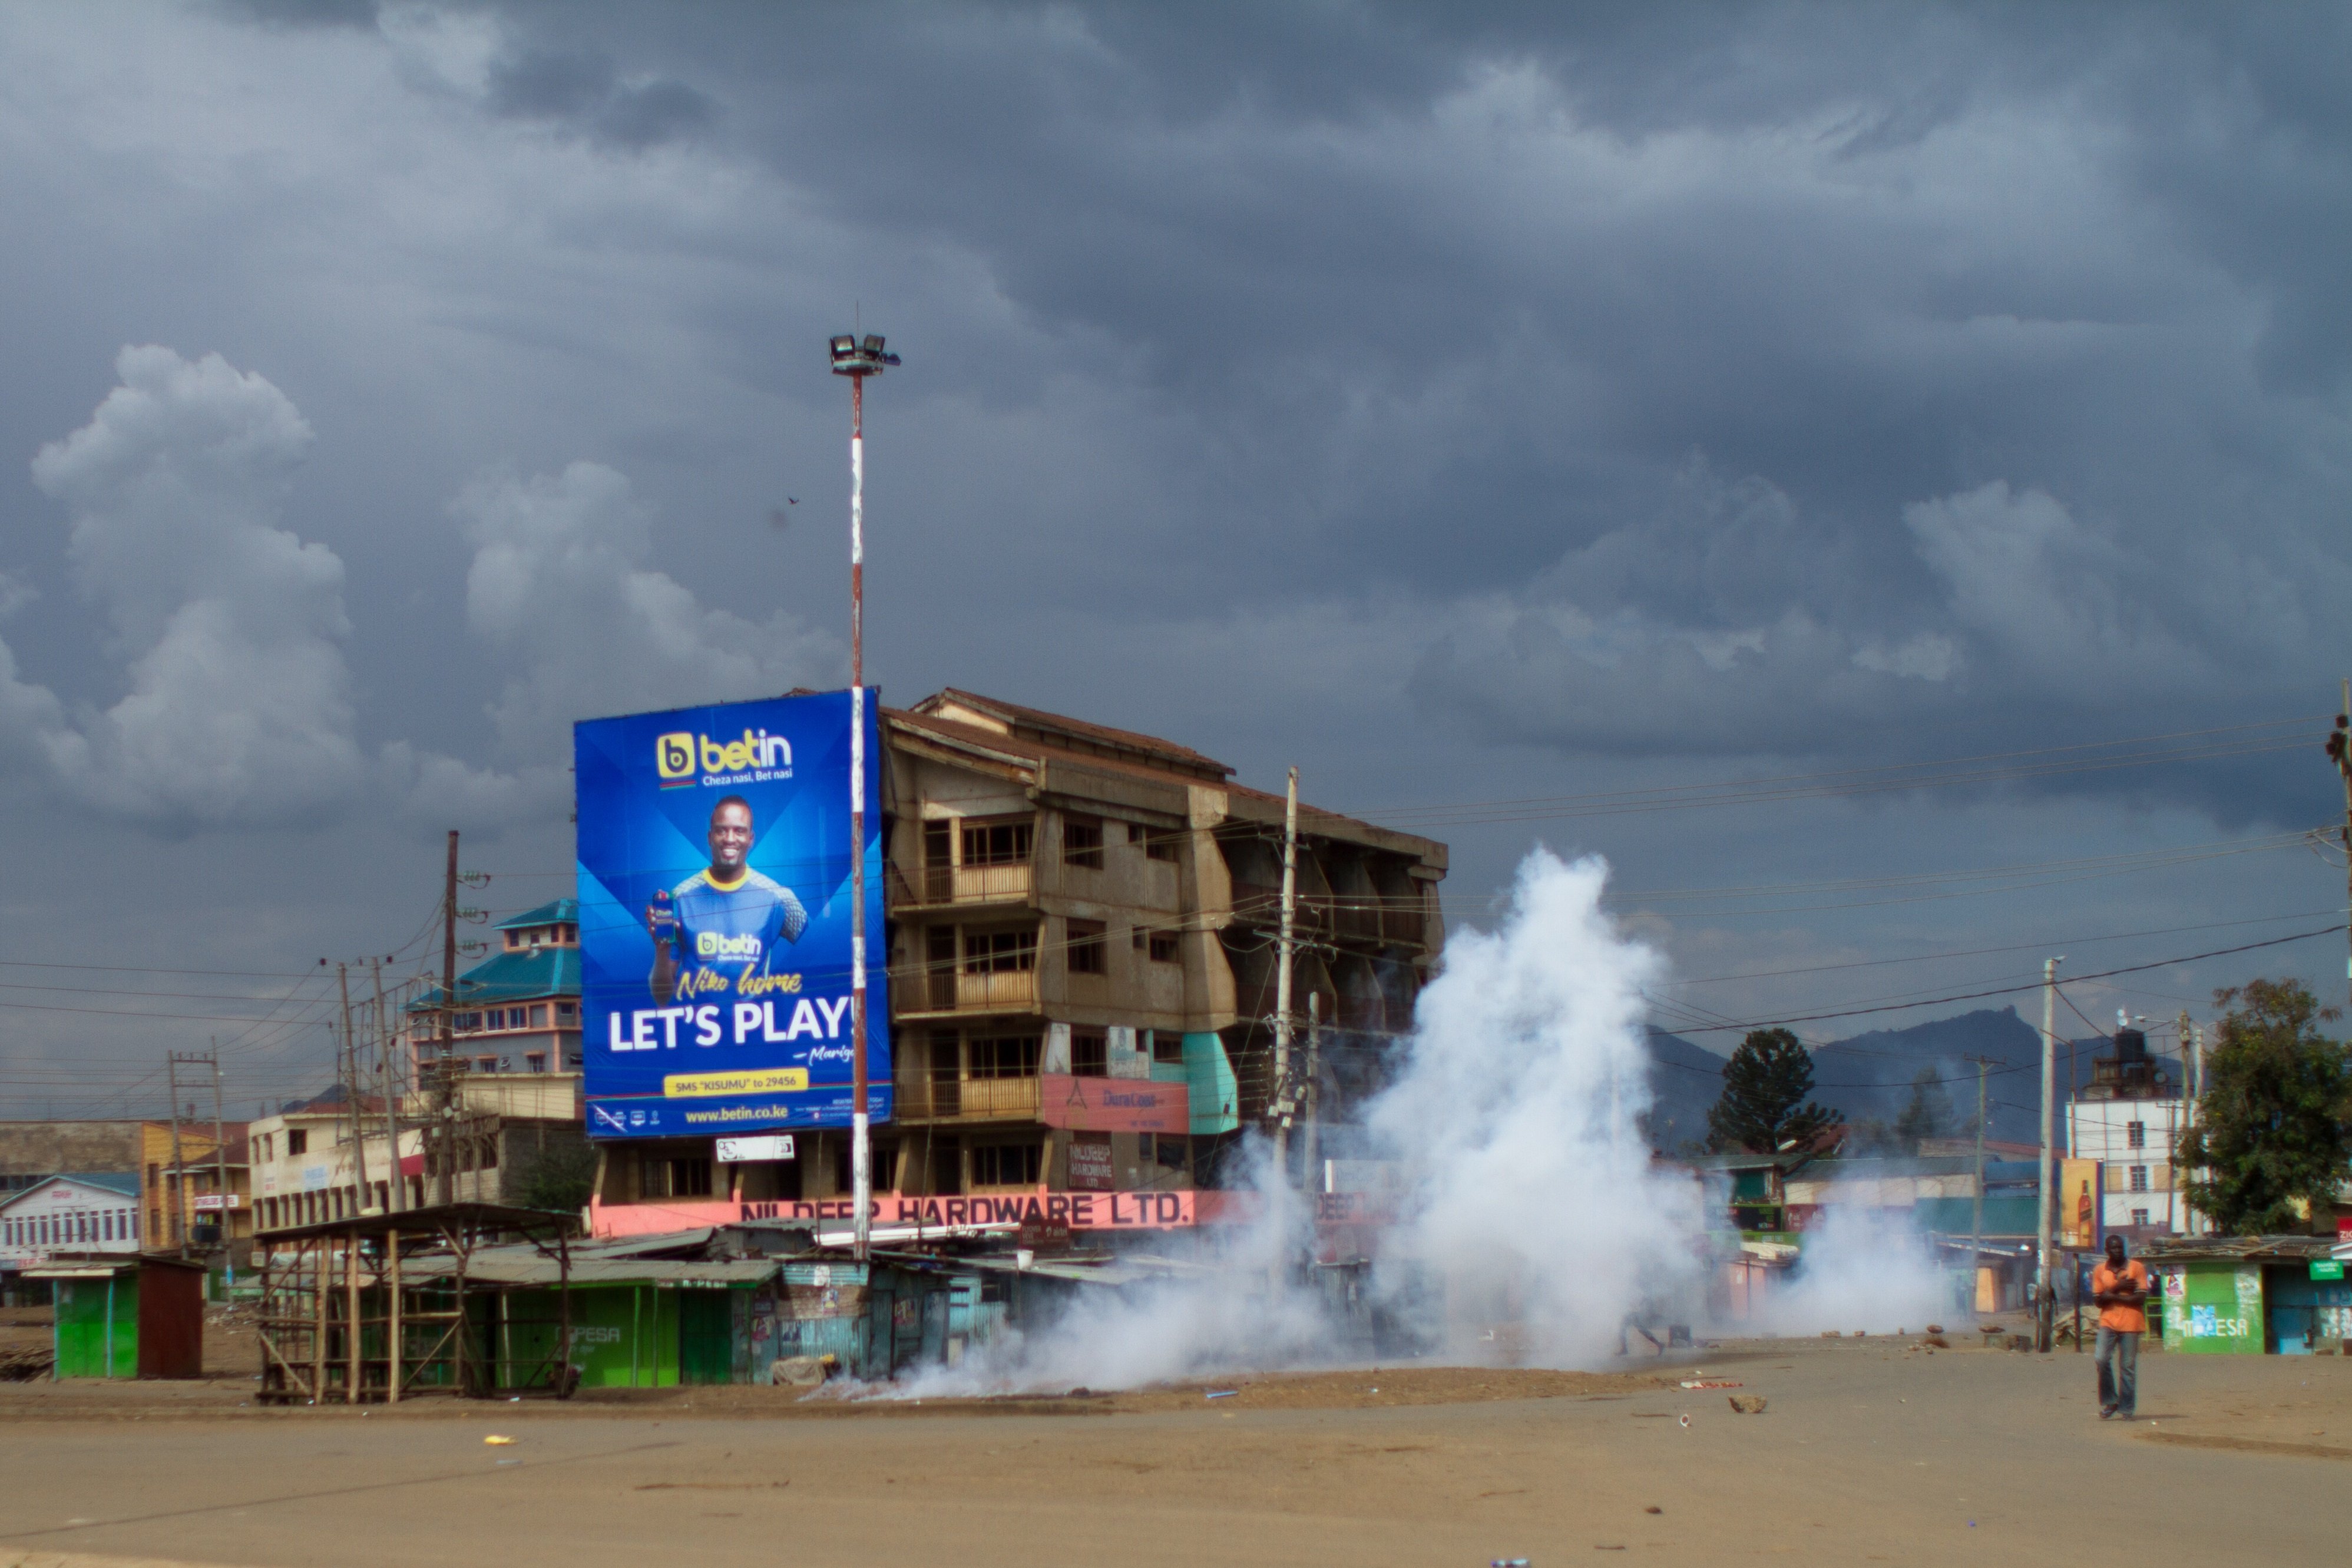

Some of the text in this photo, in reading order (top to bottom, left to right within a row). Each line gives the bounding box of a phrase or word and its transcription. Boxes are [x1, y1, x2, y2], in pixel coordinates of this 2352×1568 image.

[700, 729, 792, 773] betin
[703, 768, 792, 786] Cheza nasi, Bet nasi
[718, 933, 761, 955] betin
[676, 962, 802, 1001] Niko home
[610, 1005, 722, 1051] LET'S
[676, 1081, 697, 1092] SMS
[753, 1079, 763, 1087] to
[766, 1076, 796, 1086] 29456
[686, 1105, 788, 1123] www.betin.co.ke
[1071, 1163, 1112, 1177] HARDWARE
[1087, 1177, 1098, 1187] LTD
[898, 1195, 1093, 1226] HARDWARE
[1111, 1193, 1189, 1224] LTD.
